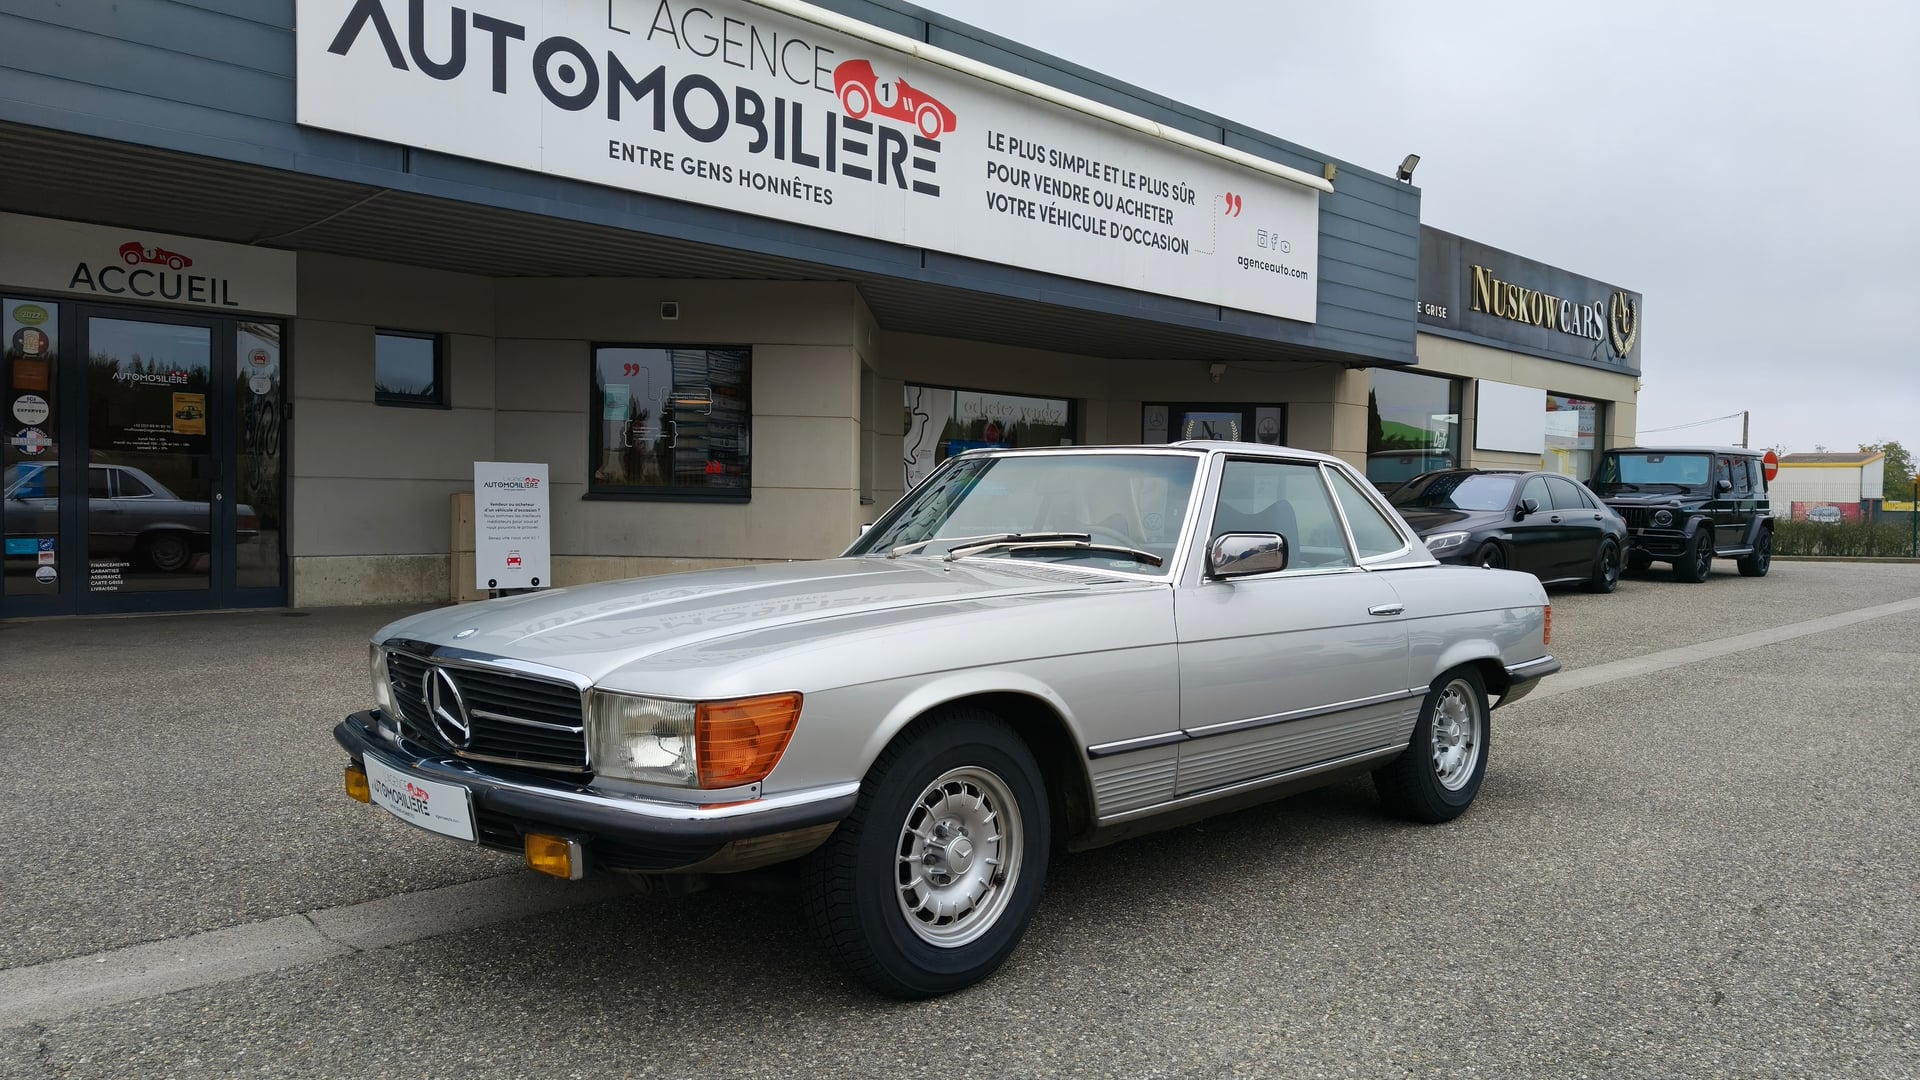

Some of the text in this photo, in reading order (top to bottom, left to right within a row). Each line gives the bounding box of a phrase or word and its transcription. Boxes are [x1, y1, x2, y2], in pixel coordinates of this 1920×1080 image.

[608, 140, 833, 205] ENTRE GENS HONNÊTES
[986, 160, 1174, 226] POUR VENDRE OU ACHETER
[987, 130, 1196, 206] LE PLUS SIMPLE ET LE PLUS SÛR
[985, 190, 1189, 256] VOTRE VÉHICULE D'OCCASION
[68, 262, 239, 306] ACCUEIL
[1237, 255, 1308, 280] agenceauto.com
[1425, 303, 1447, 320] GRISE
